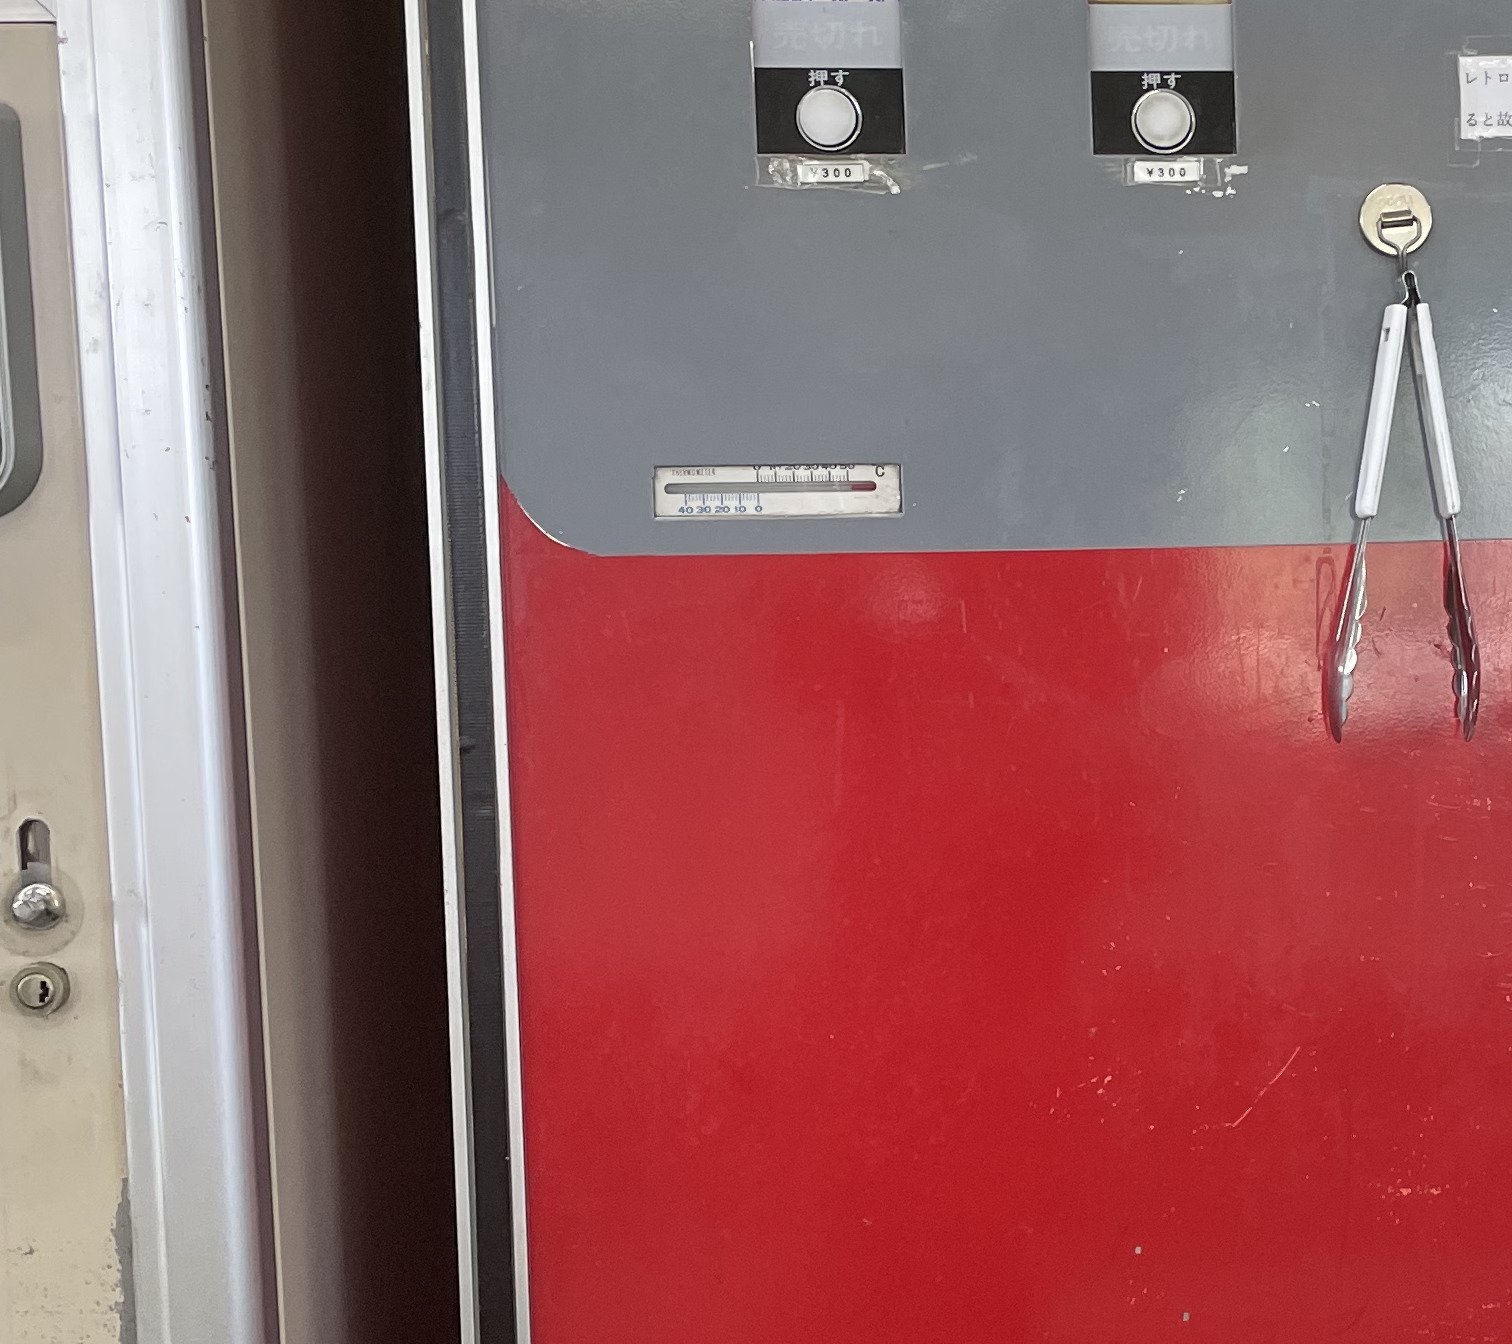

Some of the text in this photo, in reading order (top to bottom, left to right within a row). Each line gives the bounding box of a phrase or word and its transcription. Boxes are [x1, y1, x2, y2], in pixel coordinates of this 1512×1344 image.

[808, 69, 850, 86] 押す
[1141, 73, 1182, 89] 押す
[1146, 166, 1187, 178] ¥300
